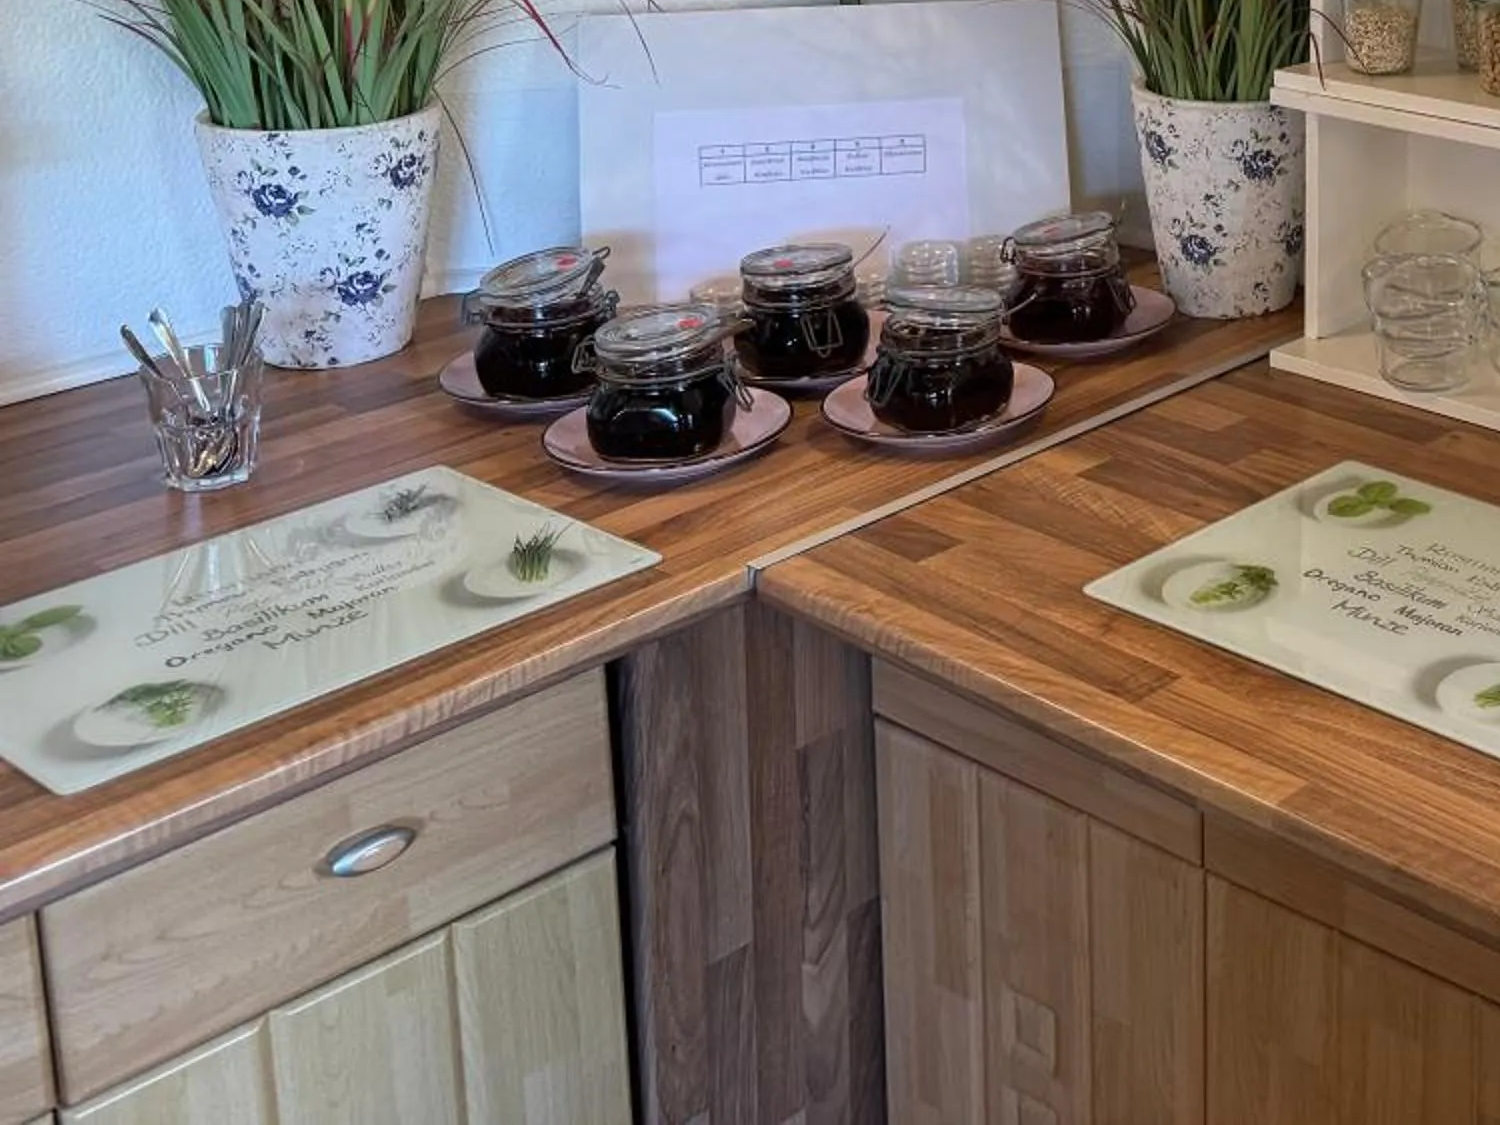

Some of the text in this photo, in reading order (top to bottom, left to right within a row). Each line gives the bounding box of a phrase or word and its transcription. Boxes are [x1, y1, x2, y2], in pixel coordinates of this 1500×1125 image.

[165, 624, 280, 668] Oregano
[307, 586, 398, 619] Majoran
[202, 592, 330, 642] Basilikum
[1302, 568, 1381, 602] Oregano
[1393, 605, 1463, 636] Majoran
